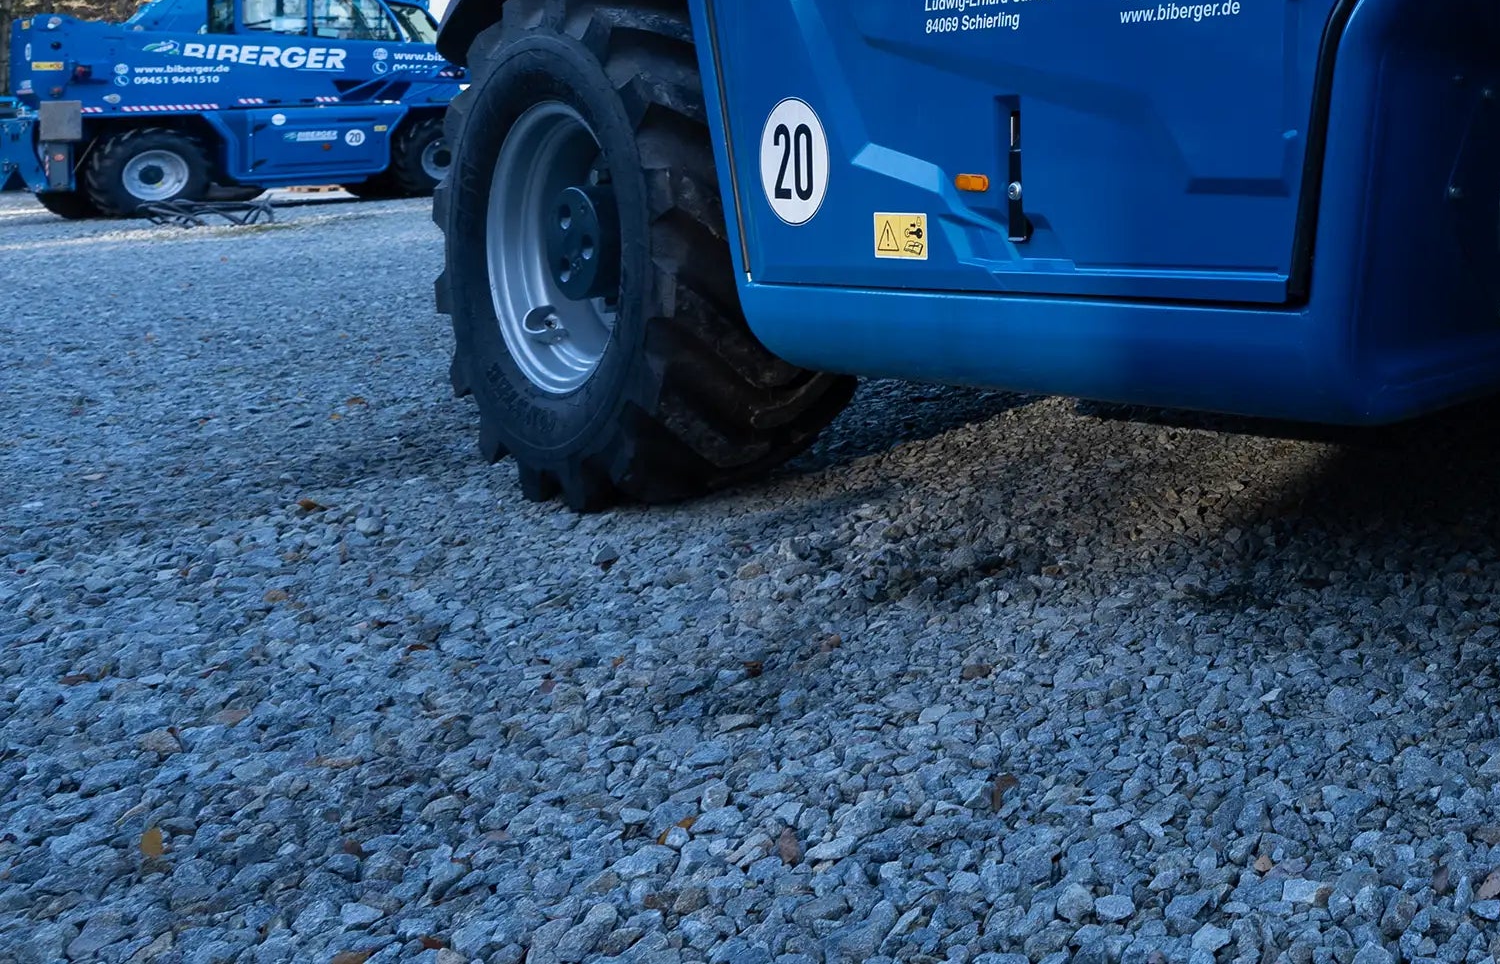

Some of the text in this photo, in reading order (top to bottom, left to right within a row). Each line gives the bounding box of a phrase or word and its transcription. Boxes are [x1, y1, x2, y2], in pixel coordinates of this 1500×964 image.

[925, 11, 1020, 34] 84069 Schierling
[134, 64, 230, 75] www.biberger.de
[134, 74, 220, 85] 09451 9441510
[349, 132, 362, 143] 20
[772, 123, 813, 201] 20
